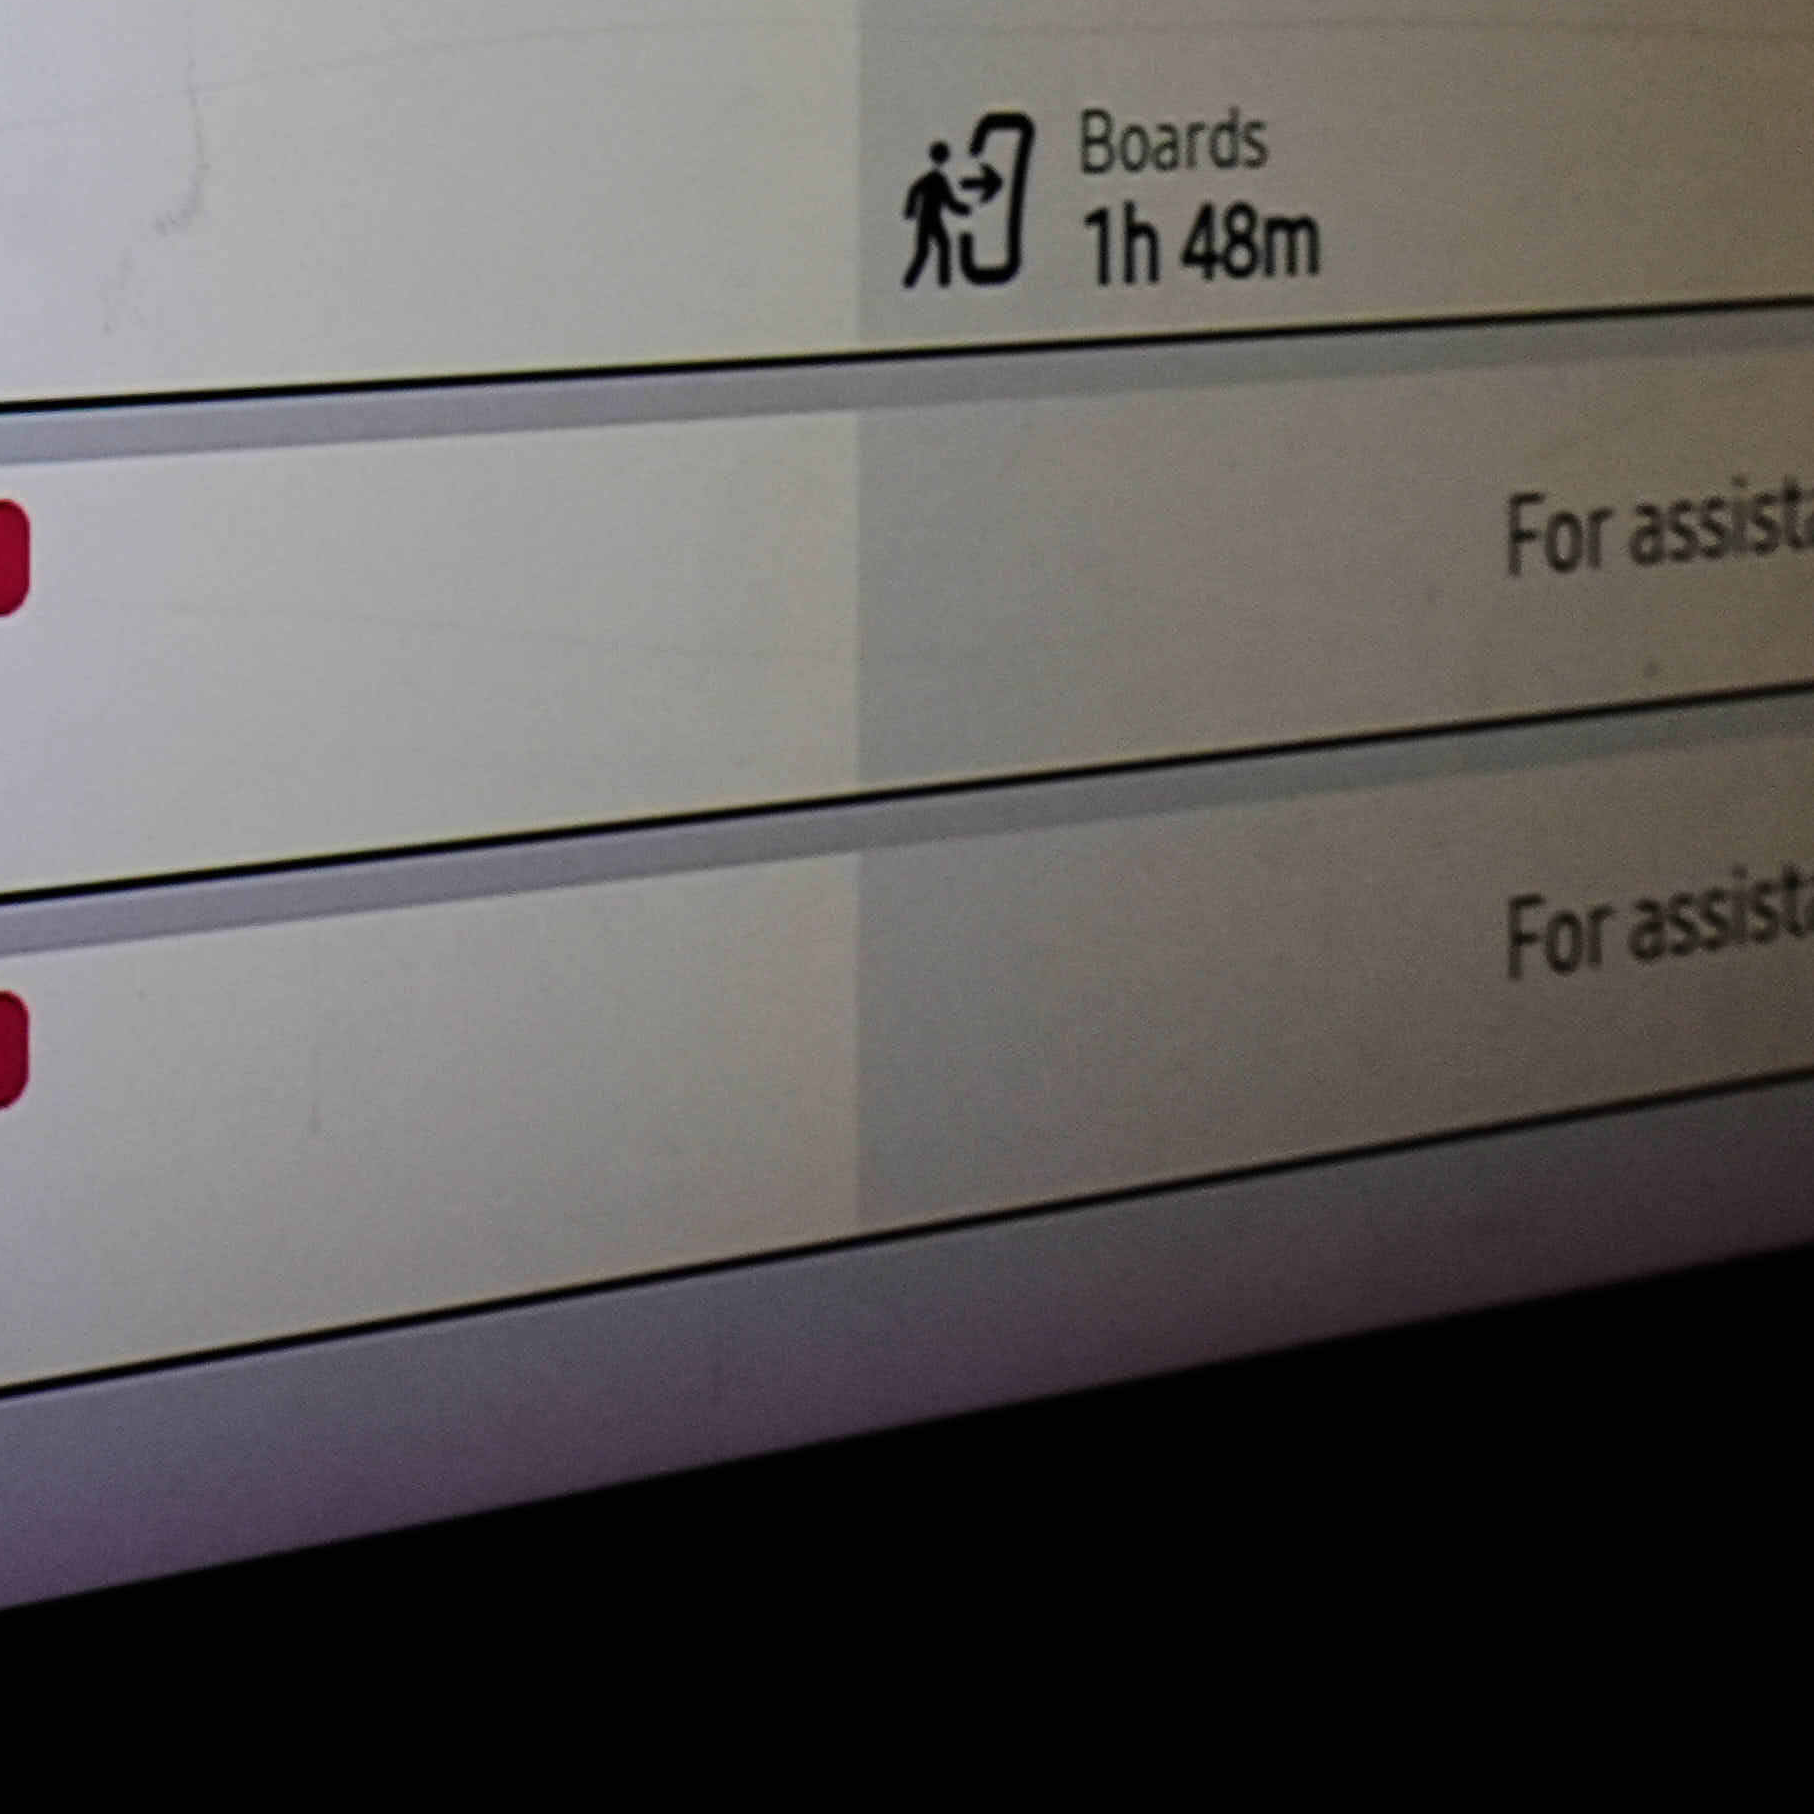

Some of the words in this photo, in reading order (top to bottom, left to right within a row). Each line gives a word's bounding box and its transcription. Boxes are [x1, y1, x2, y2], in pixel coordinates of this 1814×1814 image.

[1080, 108, 1269, 175] Boards
[1085, 202, 1160, 285] 1h
[1181, 202, 1320, 280] 48m
[1508, 492, 1613, 575] For
[1629, 478, 1814, 566] assist
[1509, 894, 1613, 979] For
[1629, 866, 1814, 963] assist
